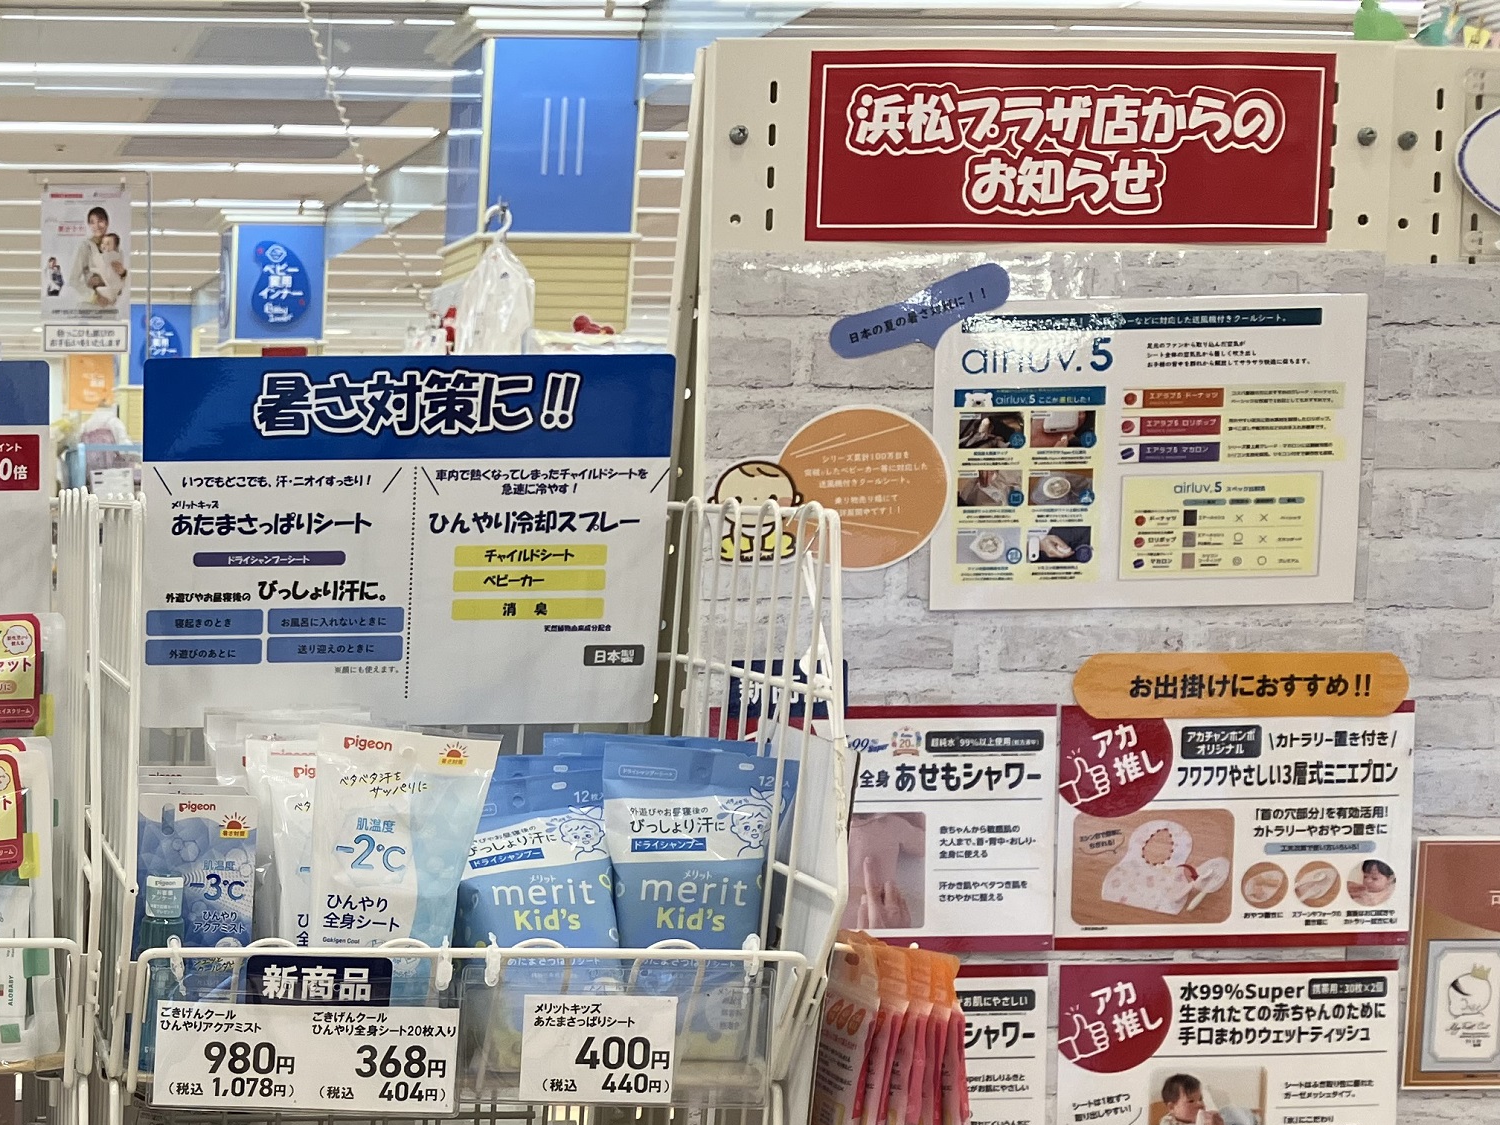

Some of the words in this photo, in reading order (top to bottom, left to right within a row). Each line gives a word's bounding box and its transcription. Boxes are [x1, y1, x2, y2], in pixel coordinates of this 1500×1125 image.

[850, 88, 1281, 152] 浜松プラザ店からの
[966, 158, 1161, 210] お知らせ
[262, 264, 299, 277] ベビー
[258, 287, 303, 300] インナー
[254, 371, 580, 437] 暑さ対策に!!
[182, 475, 371, 488] いつでもどこでも、汗・ニオイすっきり！
[436, 469, 648, 481] 車内で熱くなってしまったチャイルドシートを
[172, 500, 219, 509] メリットキッズ
[171, 513, 372, 536] あたまさっぱりシート
[429, 510, 640, 534] ひんやり冷却スプレー
[485, 549, 574, 563] チャイルドシート
[1150, 558, 1173, 566] マカロン
[483, 574, 544, 587] ベビーカー
[175, 618, 232, 628] 寝起きのとき
[281, 617, 387, 627] お風呂に入れないときに
[594, 649, 635, 664] 日本製
[1129, 674, 1372, 700] お出掛けにおすすめ!!
[1092, 724, 1138, 759] アカ
[1275, 730, 1389, 748] カトラリー置き付き
[860, 770, 891, 788] 全身
[895, 763, 1042, 792] あせもシャワー
[1112, 750, 1164, 786] 推し
[1177, 760, 1399, 788] フワフワやさしい3層式ミニエプロン
[356, 817, 396, 833] 肌温度
[630, 817, 726, 834] びっしょり汗に
[939, 825, 1020, 834] 赤ちゃんから敏感肌の
[939, 850, 988, 859] 全身に使える
[492, 878, 596, 906] merit
[641, 877, 748, 906] merit
[327, 894, 388, 912] ひんやり
[194, 922, 245, 934] アクアミスト
[323, 912, 400, 932] 全身シート
[656, 906, 726, 932] Kid's
[261, 963, 372, 1003] 新商品
[1180, 982, 1305, 1001] 水99%Super
[1090, 982, 1137, 1014] アカ
[160, 1006, 237, 1022] ごきげんクール
[534, 1002, 602, 1015] メリットキッズ
[1178, 1002, 1387, 1024] 生まれたての赤ちゃんのために
[160, 1018, 262, 1035] ひんやりアクアミスト
[312, 1022, 457, 1039] ひんやり全身シート20枚入り
[1112, 1007, 1163, 1042] 推し
[964, 1022, 1036, 1048] シャワー
[1178, 1026, 1371, 1046] 手口まわりウェットティッシュ
[203, 1040, 295, 1077] 980円
[354, 1044, 447, 1081] 368円
[575, 1035, 671, 1071] 400円
